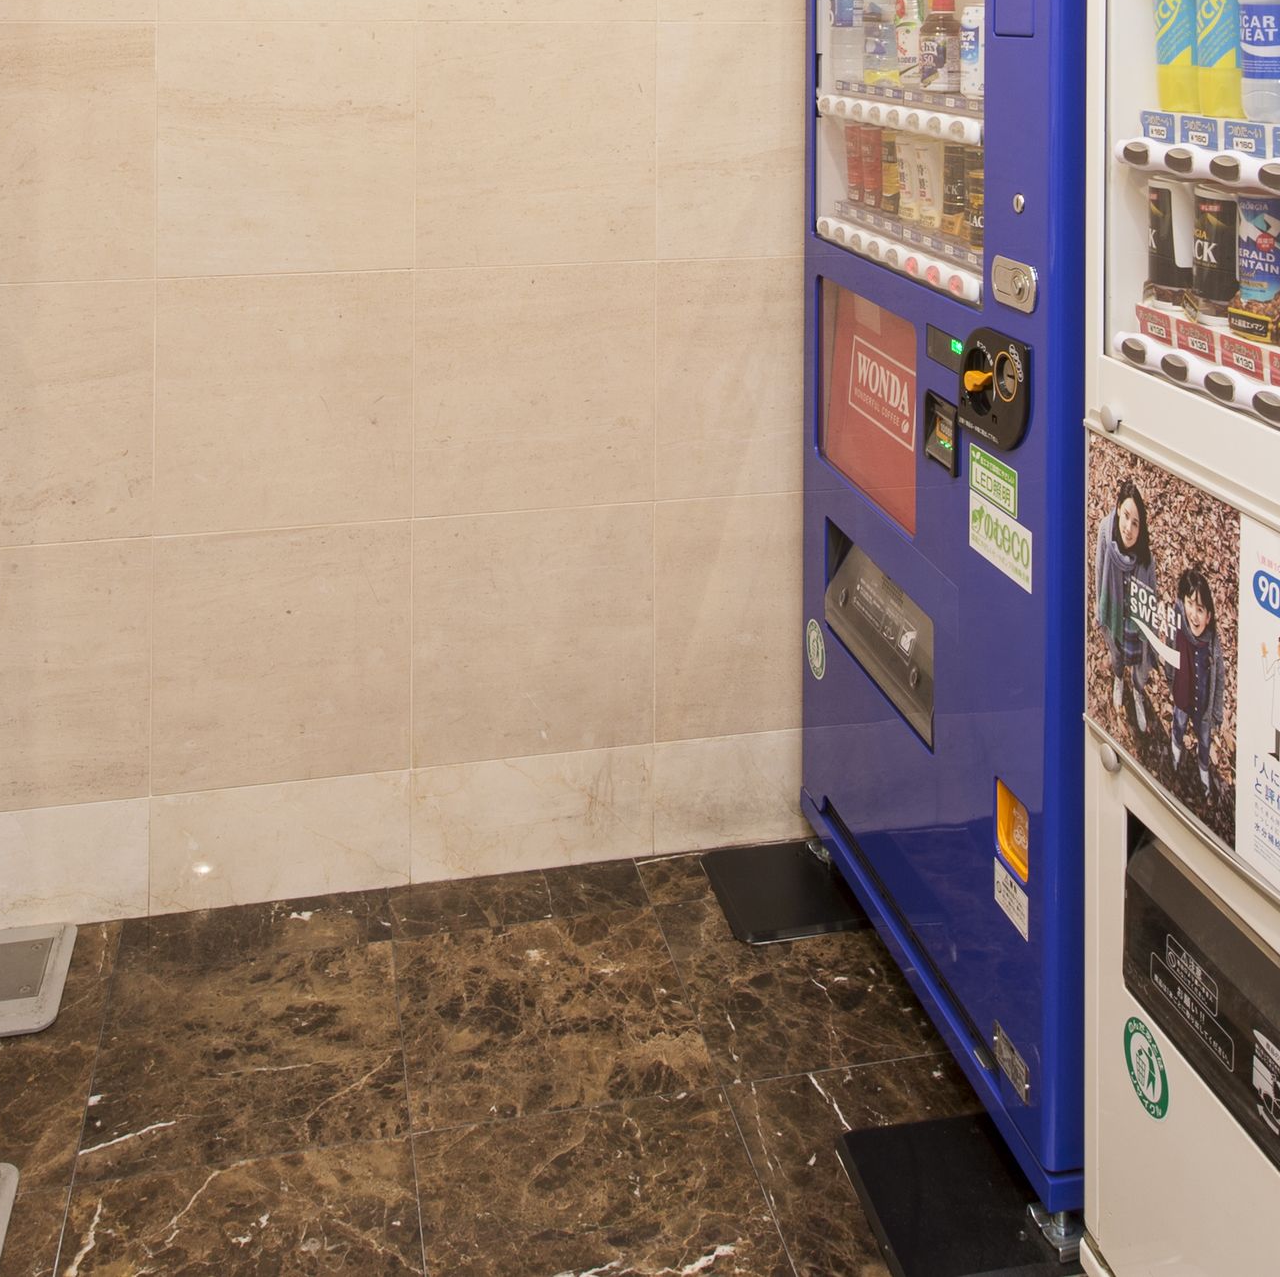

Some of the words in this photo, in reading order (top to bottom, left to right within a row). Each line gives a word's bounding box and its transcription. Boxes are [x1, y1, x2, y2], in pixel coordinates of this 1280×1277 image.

[856, 350, 910, 418] WONDA
[881, 405, 901, 428] COFFEE
[974, 467, 1012, 508] LED照明
[1130, 581, 1182, 630] POCARI
[1130, 597, 1177, 641] SWEAT
